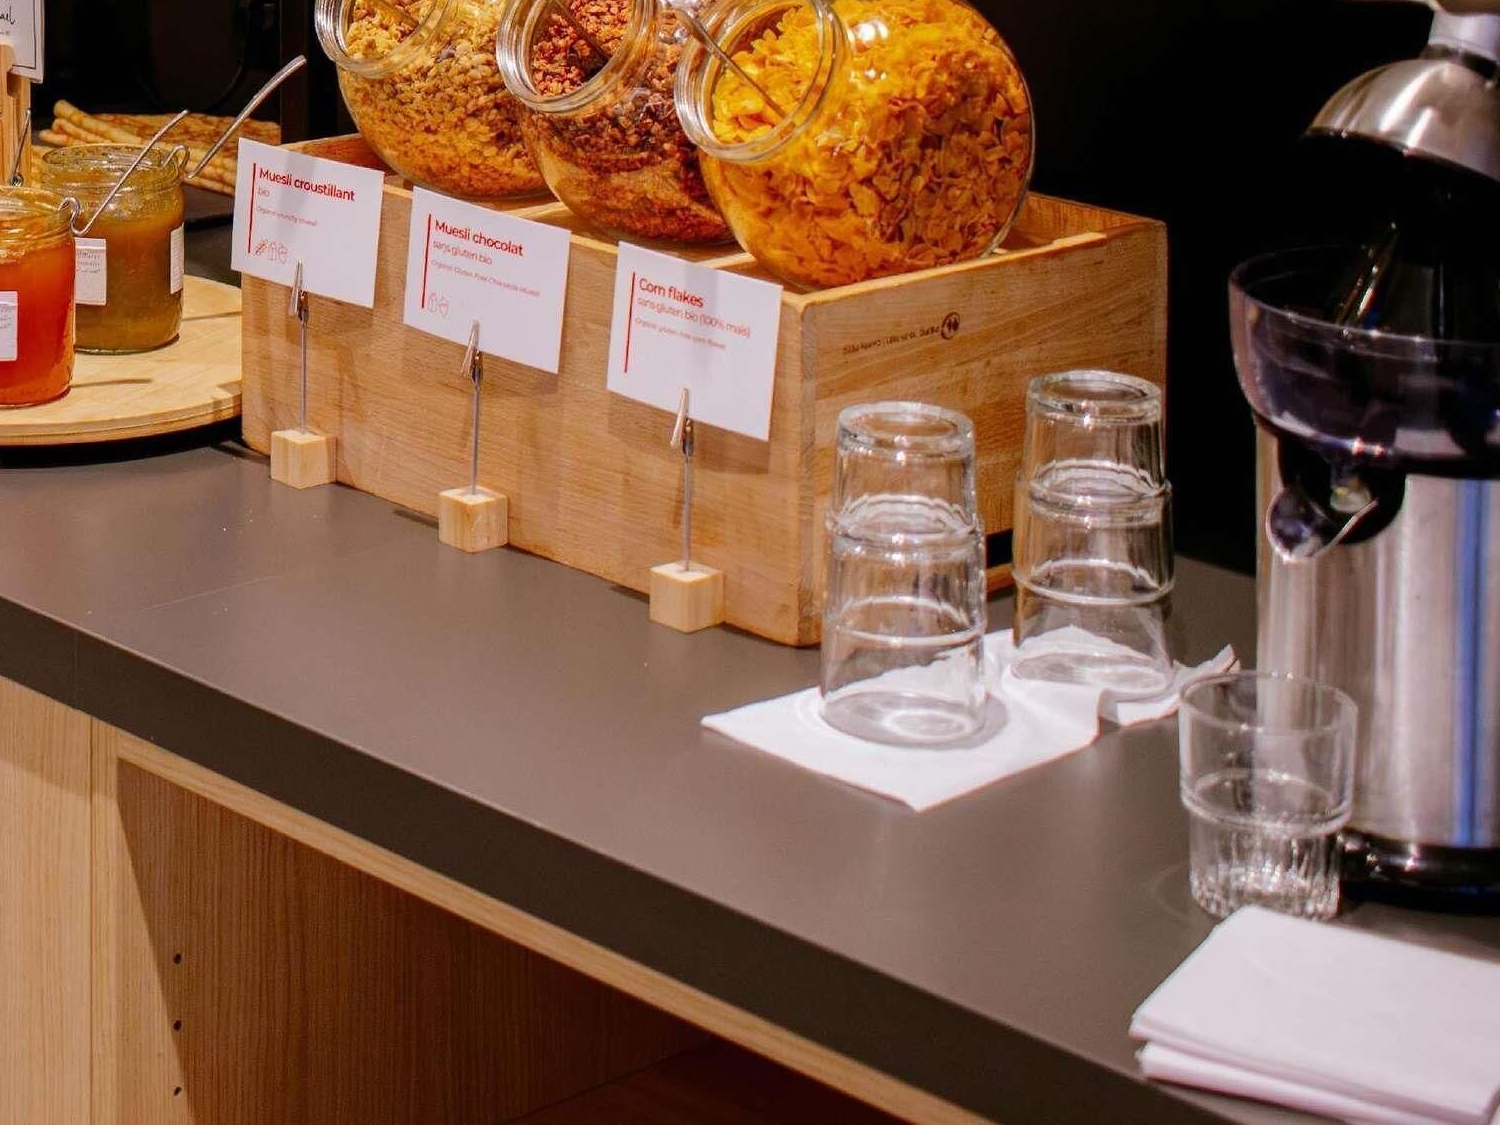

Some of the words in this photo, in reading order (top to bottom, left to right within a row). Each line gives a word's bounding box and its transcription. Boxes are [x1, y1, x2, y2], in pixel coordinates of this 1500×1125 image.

[259, 167, 292, 187] Muesli
[294, 178, 355, 202] croustillant
[435, 219, 470, 241] Muesli
[472, 232, 523, 257] chocolat
[433, 241, 450, 253] sans
[451, 246, 478, 261] gluten
[478, 252, 493, 266] bio
[639, 278, 665, 297] Corn
[668, 286, 704, 308] flakes
[656, 302, 684, 318] gluten
[684, 310, 698, 323] bio
